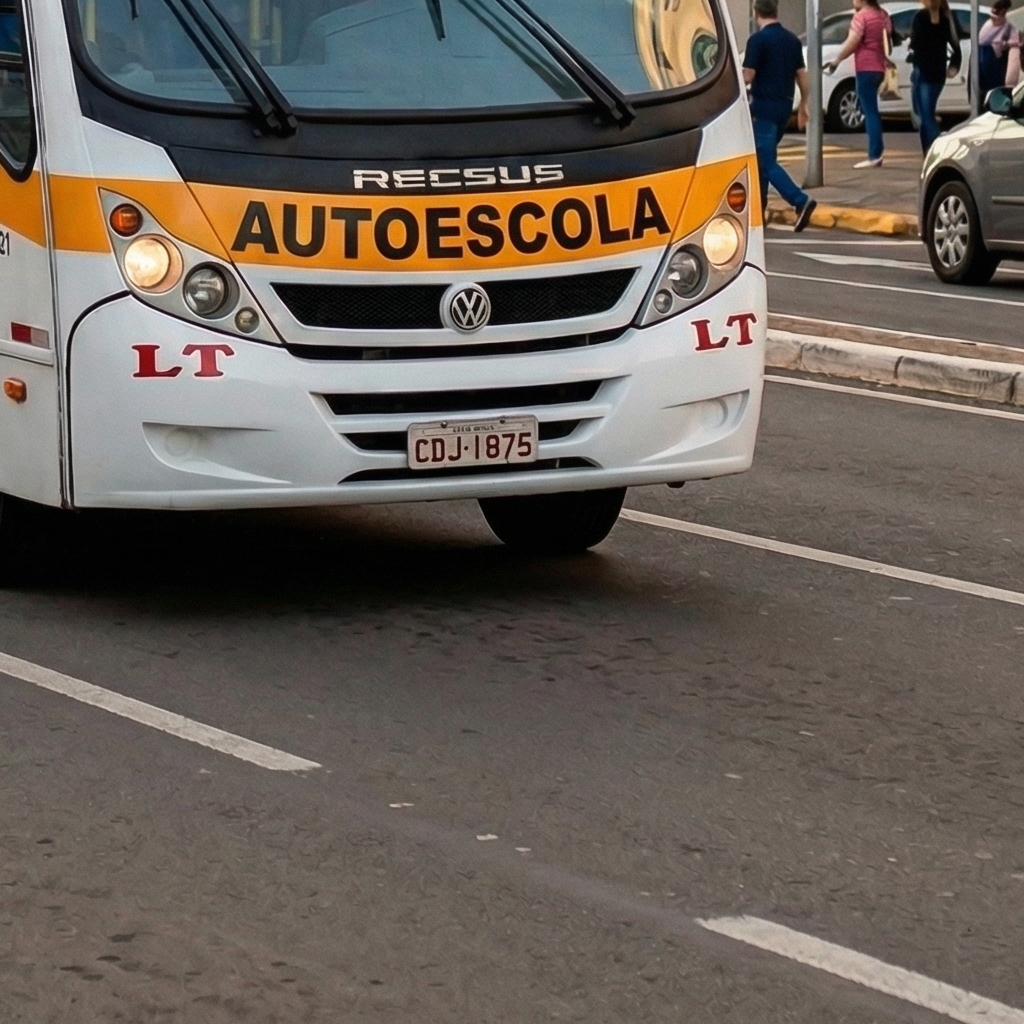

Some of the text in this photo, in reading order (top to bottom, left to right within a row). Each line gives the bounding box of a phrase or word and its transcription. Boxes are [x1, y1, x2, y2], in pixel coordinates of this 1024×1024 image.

[231, 186, 671, 261] AUTOESCOLA
[691, 311, 758, 352] LT
[132, 343, 235, 379] LT
